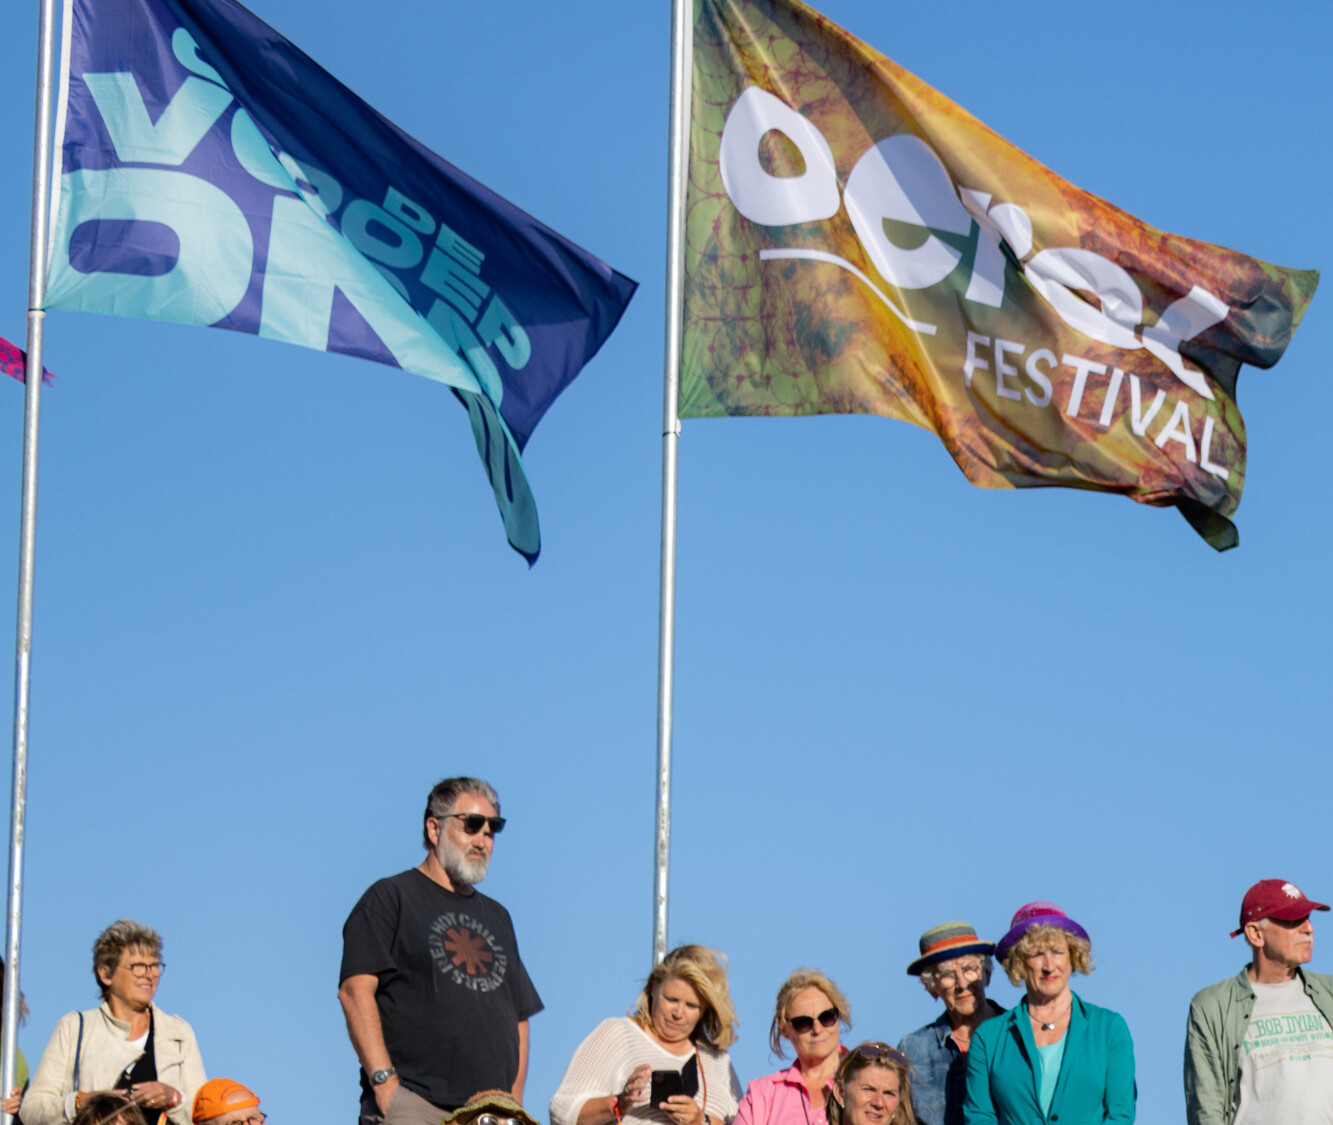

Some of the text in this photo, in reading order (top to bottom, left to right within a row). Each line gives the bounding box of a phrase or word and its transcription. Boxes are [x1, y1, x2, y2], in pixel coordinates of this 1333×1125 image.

[963, 330, 1230, 481] FESTIVAL
[430, 912, 458, 935] HOT
[1255, 1013, 1325, 1039] BOB DYLAN
